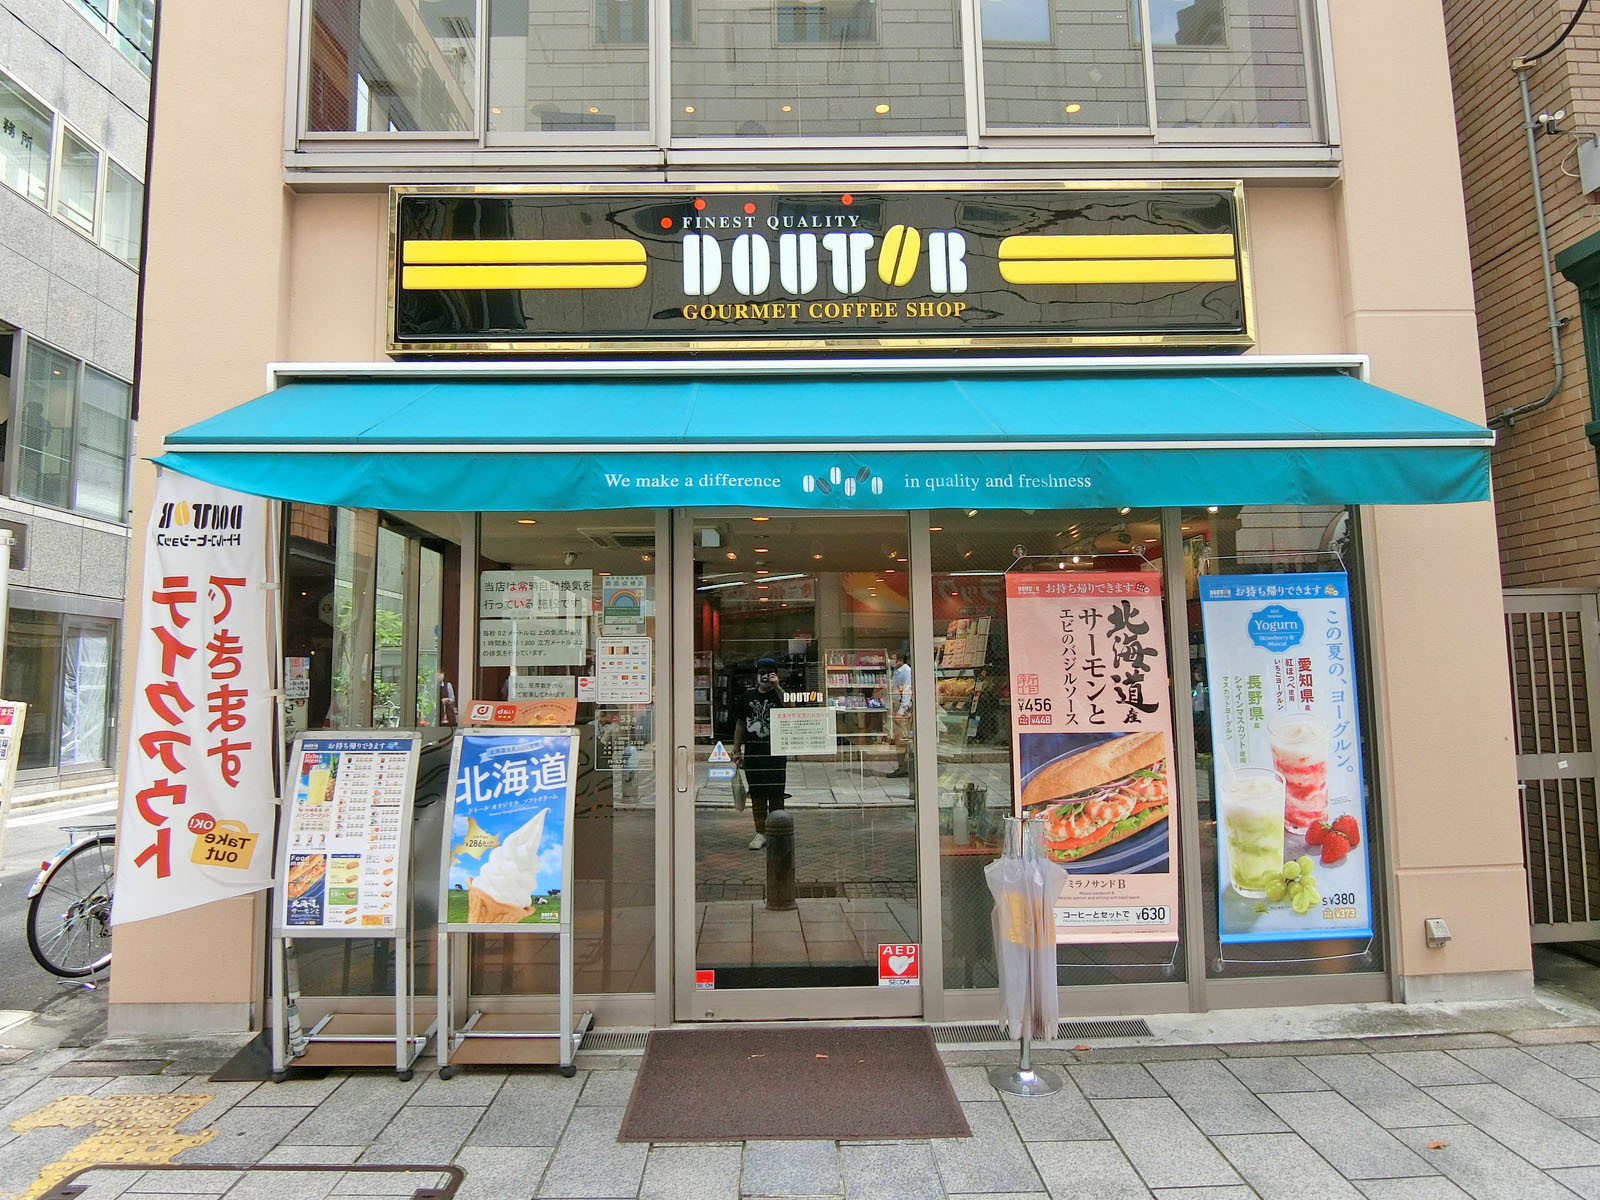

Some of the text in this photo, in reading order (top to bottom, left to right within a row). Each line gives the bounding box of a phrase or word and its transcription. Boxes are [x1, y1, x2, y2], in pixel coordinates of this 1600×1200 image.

[682, 215, 860, 229] FINEST QUALITY
[682, 224, 968, 296] DOUTOR
[682, 302, 967, 321] GOURMET COFFEE SHOP
[604, 473, 782, 488] We make a difference
[904, 473, 1092, 491] in quality and freshness
[1045, 582, 1133, 594] お持ち帰りできます
[1234, 584, 1322, 597] お持ち帰りできます
[1254, 619, 1298, 631] Yogurn
[1059, 608, 1079, 726] エビのバジルソース
[1078, 607, 1107, 725] サーモンと
[1106, 599, 1159, 724] 北海道産
[783, 691, 823, 703] DOUTOR
[1325, 610, 1354, 773] この夏の、ヨーグルン。
[1018, 698, 1052, 712] ¥456
[328, 742, 386, 750] お持ち帰りできます
[456, 752, 568, 805] 北海道
[465, 839, 483, 847] ¥286
[1322, 893, 1355, 906] S ¥380
[1063, 910, 1130, 919] コーヒーとセットで
[1136, 907, 1166, 920] ¥630
[882, 945, 916, 955] AED
